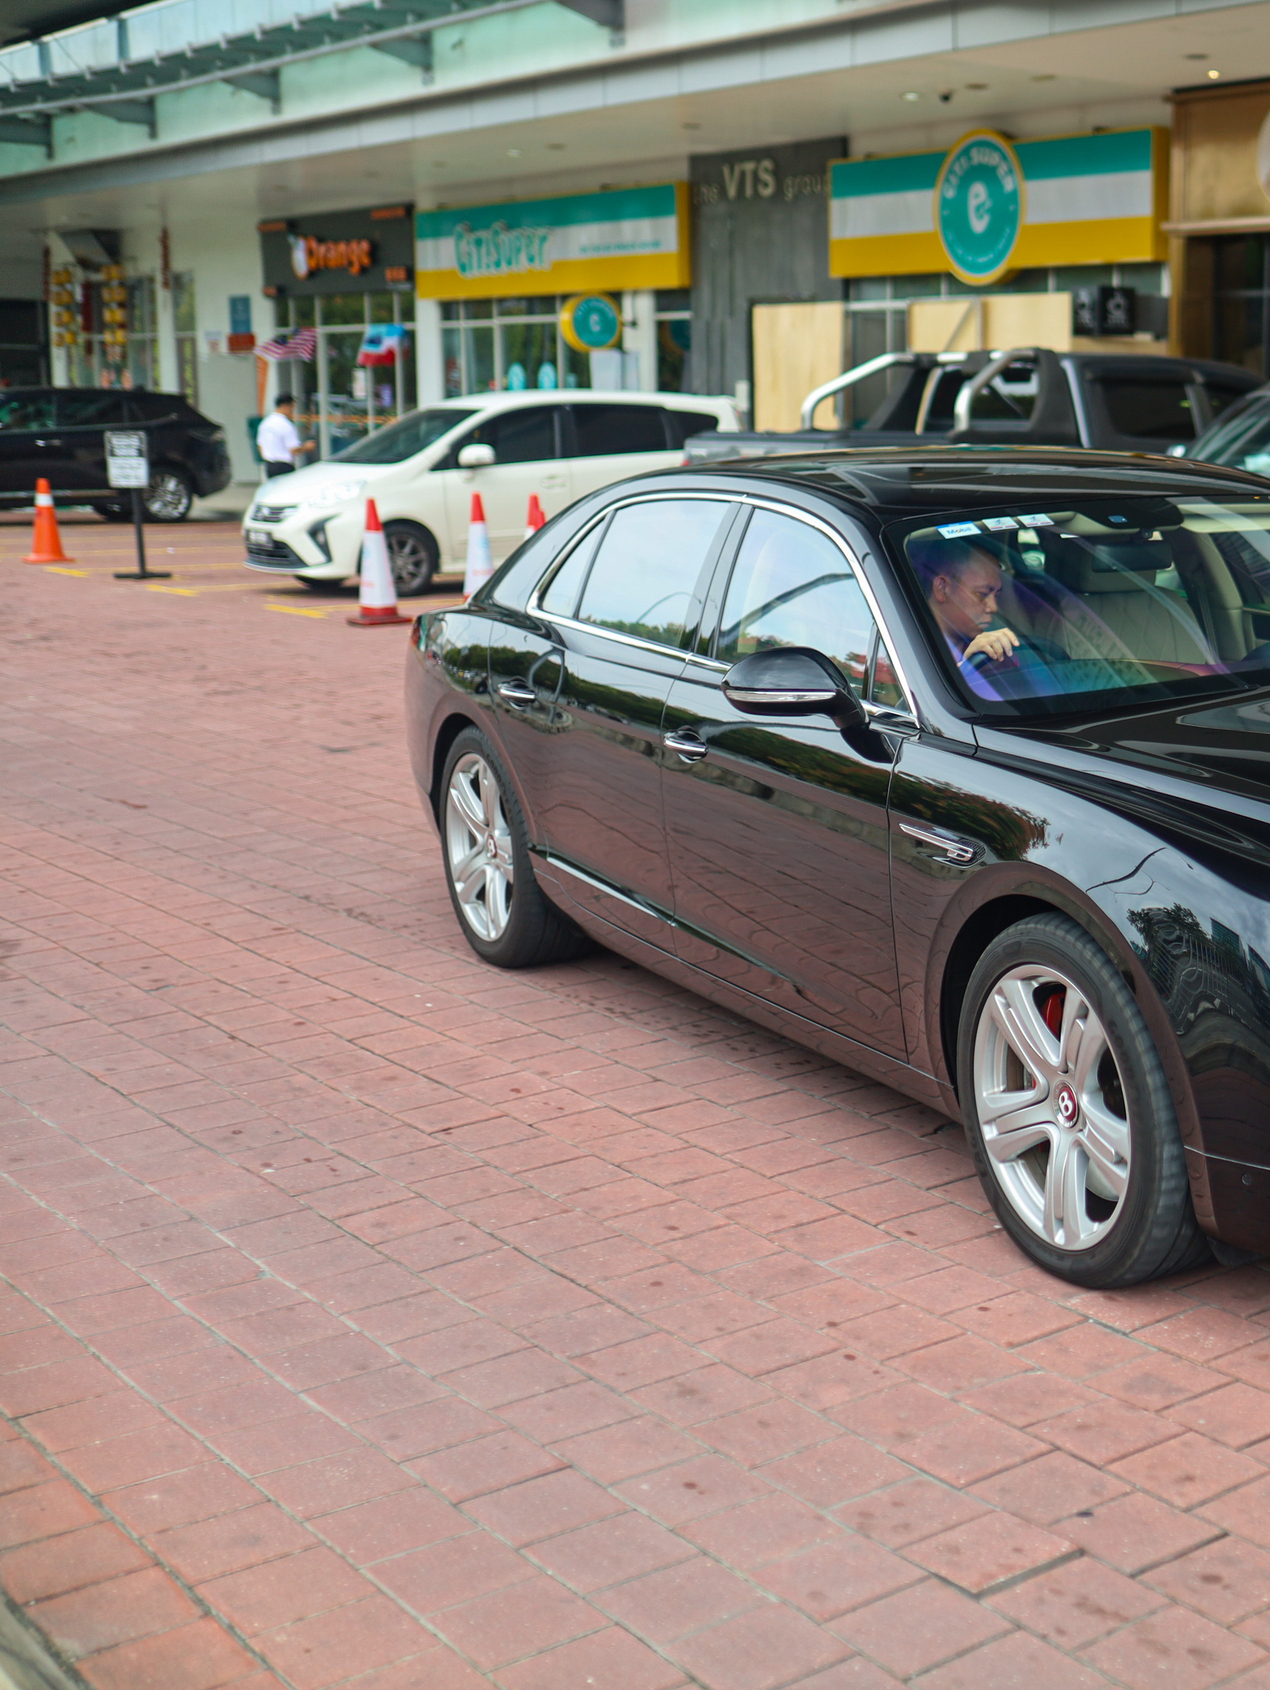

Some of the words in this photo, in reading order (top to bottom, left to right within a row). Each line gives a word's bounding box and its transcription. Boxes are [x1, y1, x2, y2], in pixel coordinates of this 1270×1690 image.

[721, 158, 776, 200] VTS
[968, 145, 1016, 195] SUPER
[301, 235, 372, 276] Orange
